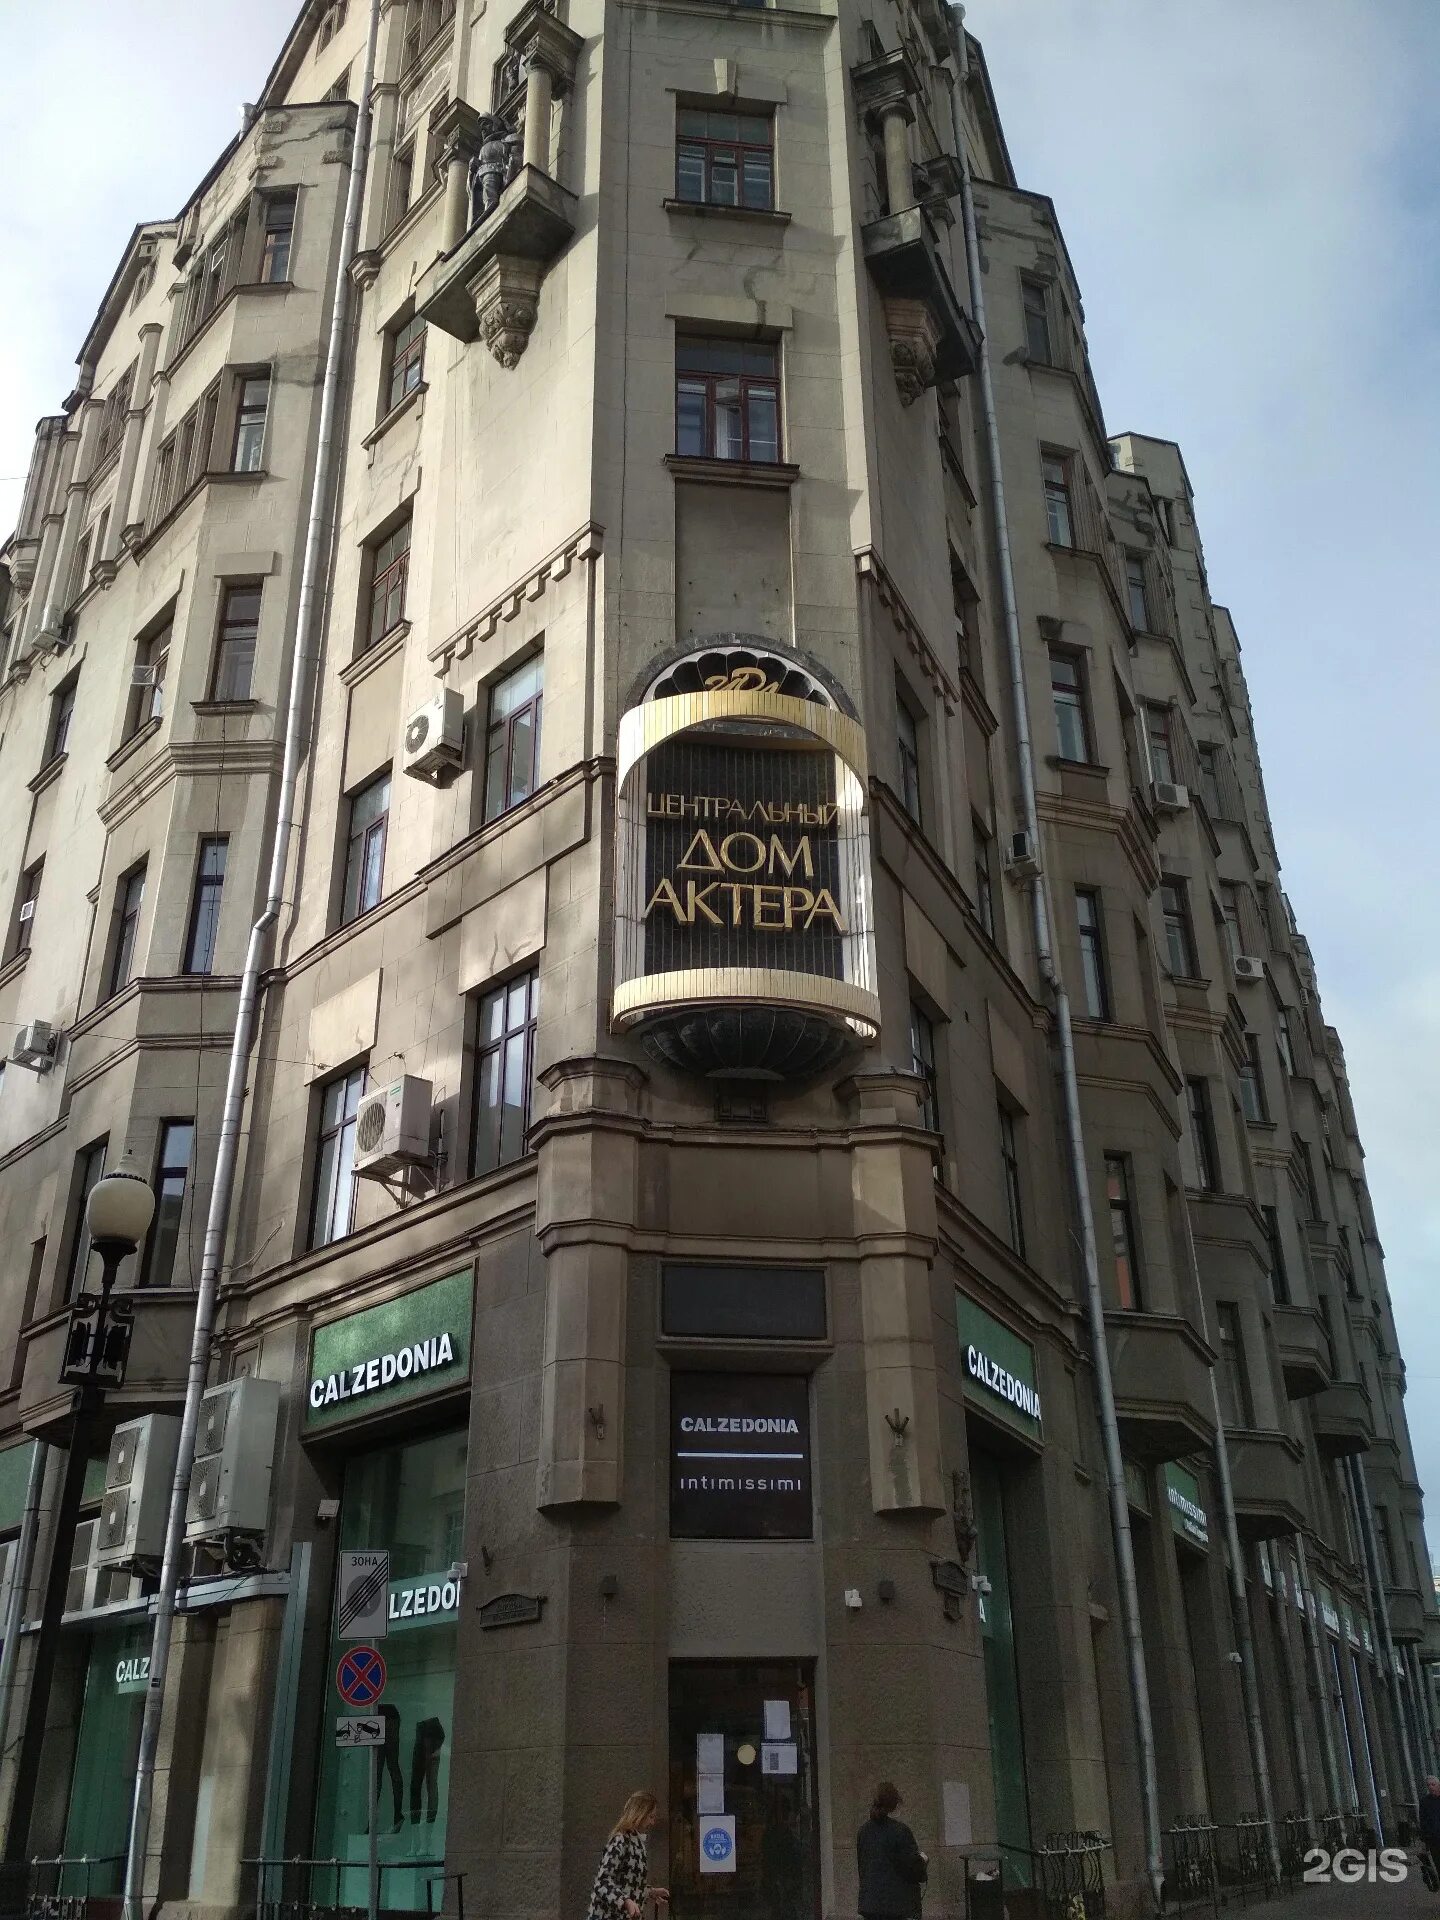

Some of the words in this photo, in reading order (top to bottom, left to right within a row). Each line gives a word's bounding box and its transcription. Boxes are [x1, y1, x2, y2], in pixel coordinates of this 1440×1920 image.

[647, 792, 841, 828] ЦЕНТРАЛЬНЫЙ
[676, 829, 814, 878] ДОМ
[642, 878, 848, 933] АКТЕРА
[310, 1333, 453, 1408] CALZEDONIA
[967, 1344, 1042, 1420] CALZEDONIA
[680, 1417, 799, 1433] CALZEDONIA
[680, 1475, 801, 1491] intimissimi
[351, 1556, 378, 1567] ЗОНА
